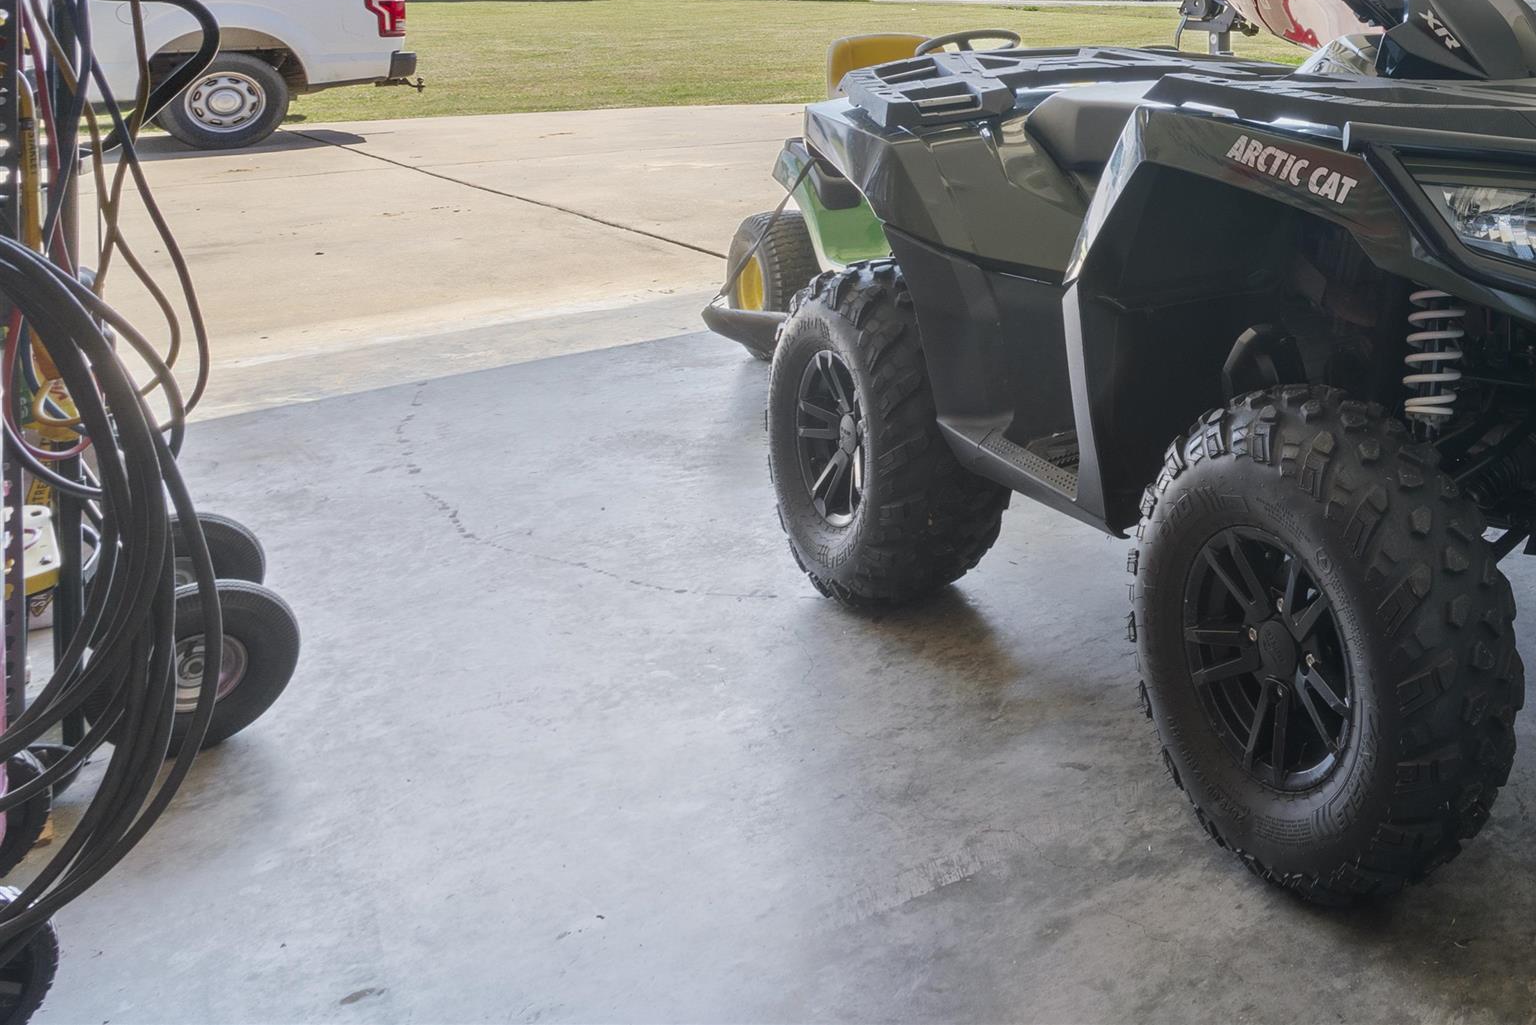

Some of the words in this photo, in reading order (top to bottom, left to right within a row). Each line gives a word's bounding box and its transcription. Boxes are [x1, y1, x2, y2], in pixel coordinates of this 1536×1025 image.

[1418, 9, 1461, 50] XR
[1225, 134, 1309, 186] ARCTIC
[1308, 166, 1358, 204] CAT
